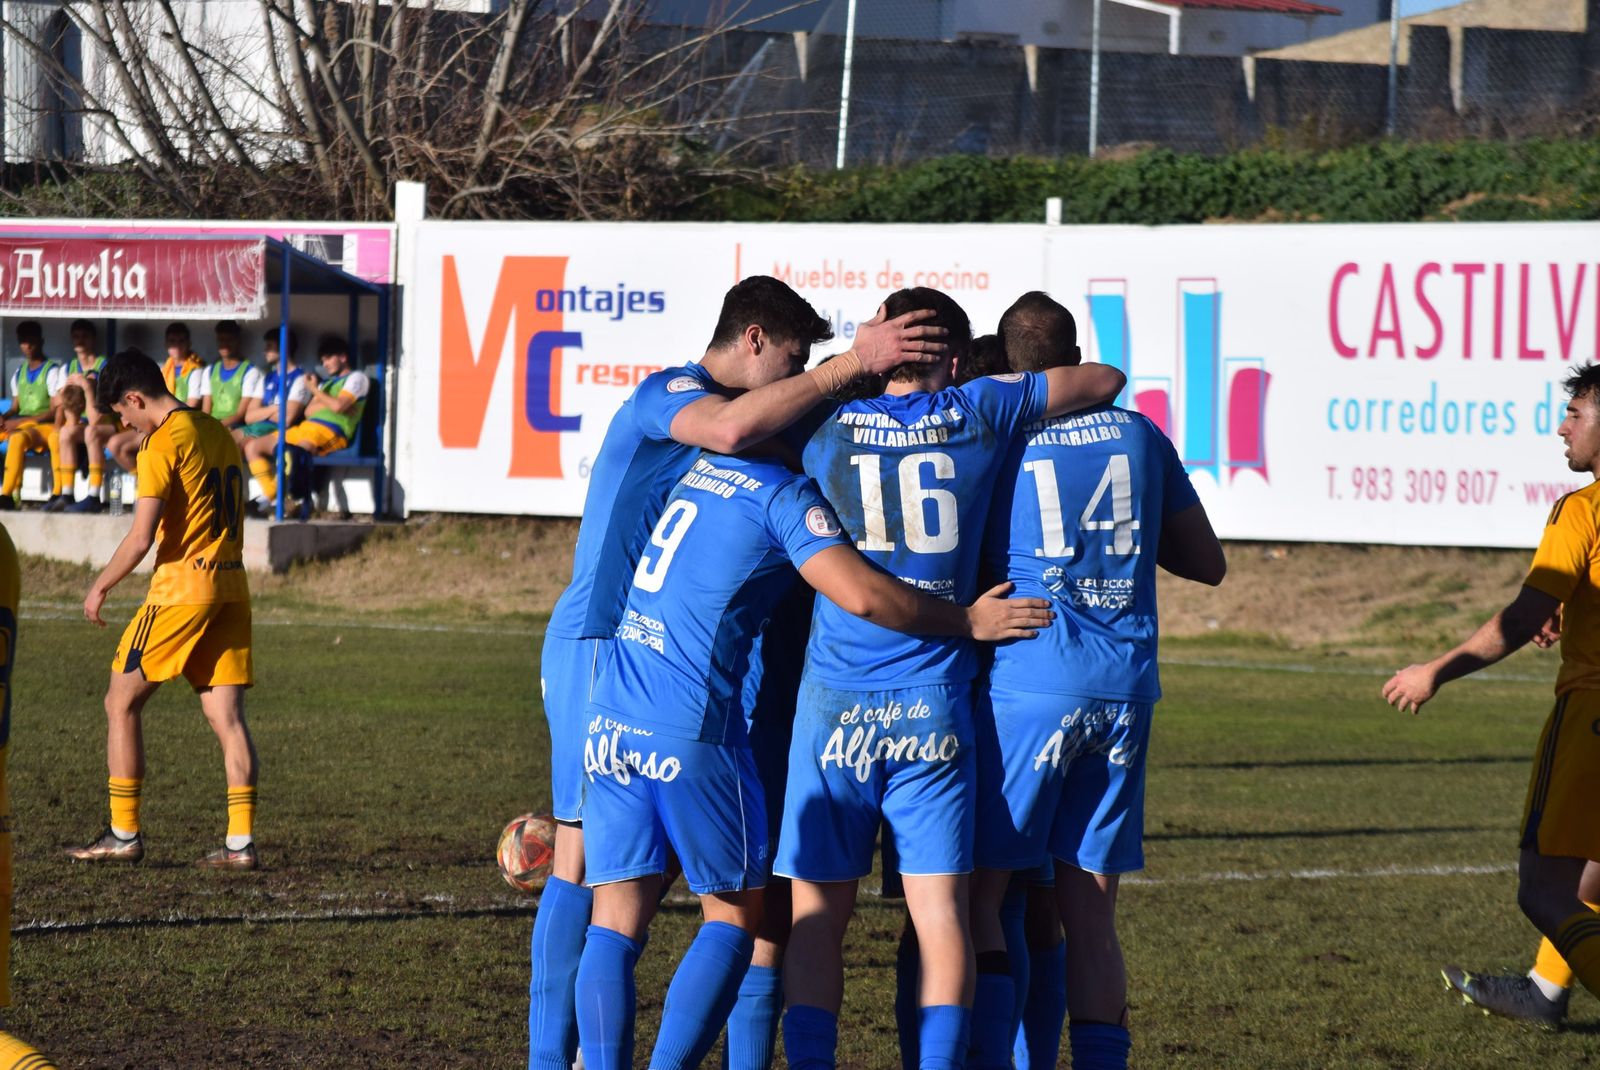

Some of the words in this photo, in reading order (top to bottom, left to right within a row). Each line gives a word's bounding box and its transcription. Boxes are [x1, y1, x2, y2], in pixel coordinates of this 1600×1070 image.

[11, 248, 147, 299] Aurelia
[773, 260, 867, 289] Muebles
[876, 260, 904, 289] de
[913, 263, 990, 290] cocina
[837, 412, 942, 430] AYUNTAMENTO
[942, 407, 962, 422] DE
[1113, 411, 1133, 424] DE
[1327, 381, 1516, 435] corredores
[853, 427, 948, 447] VILLARALBO
[203, 465, 243, 542] 10
[741, 478, 763, 492] DE
[850, 452, 959, 553] 16
[1023, 454, 1141, 557] 14
[1326, 466, 1343, 500] T.
[1352, 467, 1392, 501] 983
[1405, 469, 1447, 503] 309
[1457, 470, 1498, 505] 807
[634, 499, 698, 593] 9
[840, 704, 861, 725] el
[864, 700, 903, 729] café
[907, 698, 932, 719] de
[820, 724, 960, 783] Alfonso
